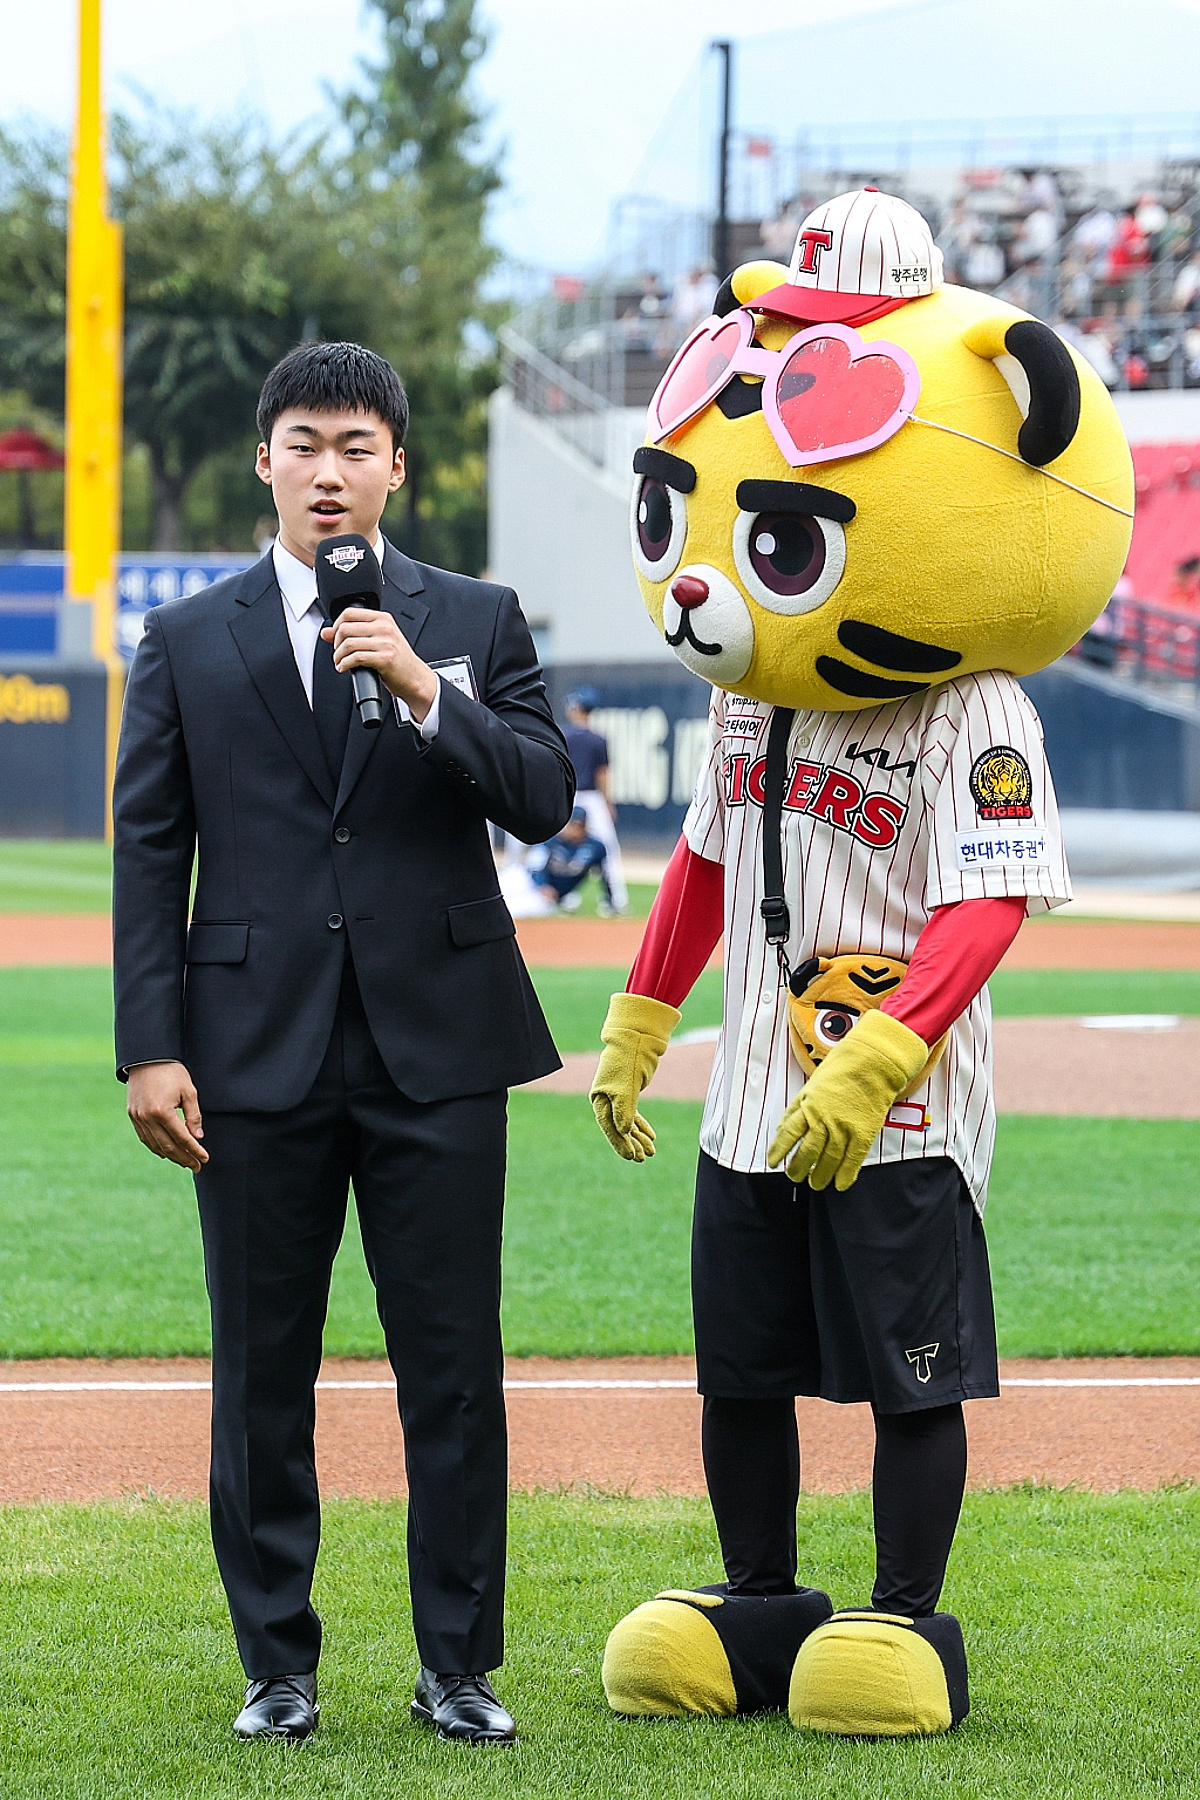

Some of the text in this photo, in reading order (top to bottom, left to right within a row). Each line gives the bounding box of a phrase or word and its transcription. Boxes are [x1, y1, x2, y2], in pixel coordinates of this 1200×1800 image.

[799, 227, 833, 275] T
[891, 267, 928, 283] 광주은행
[981, 805, 1032, 818] TIGERS
[960, 840, 1038, 862] 현대차증권
[904, 1342, 940, 1384] T
